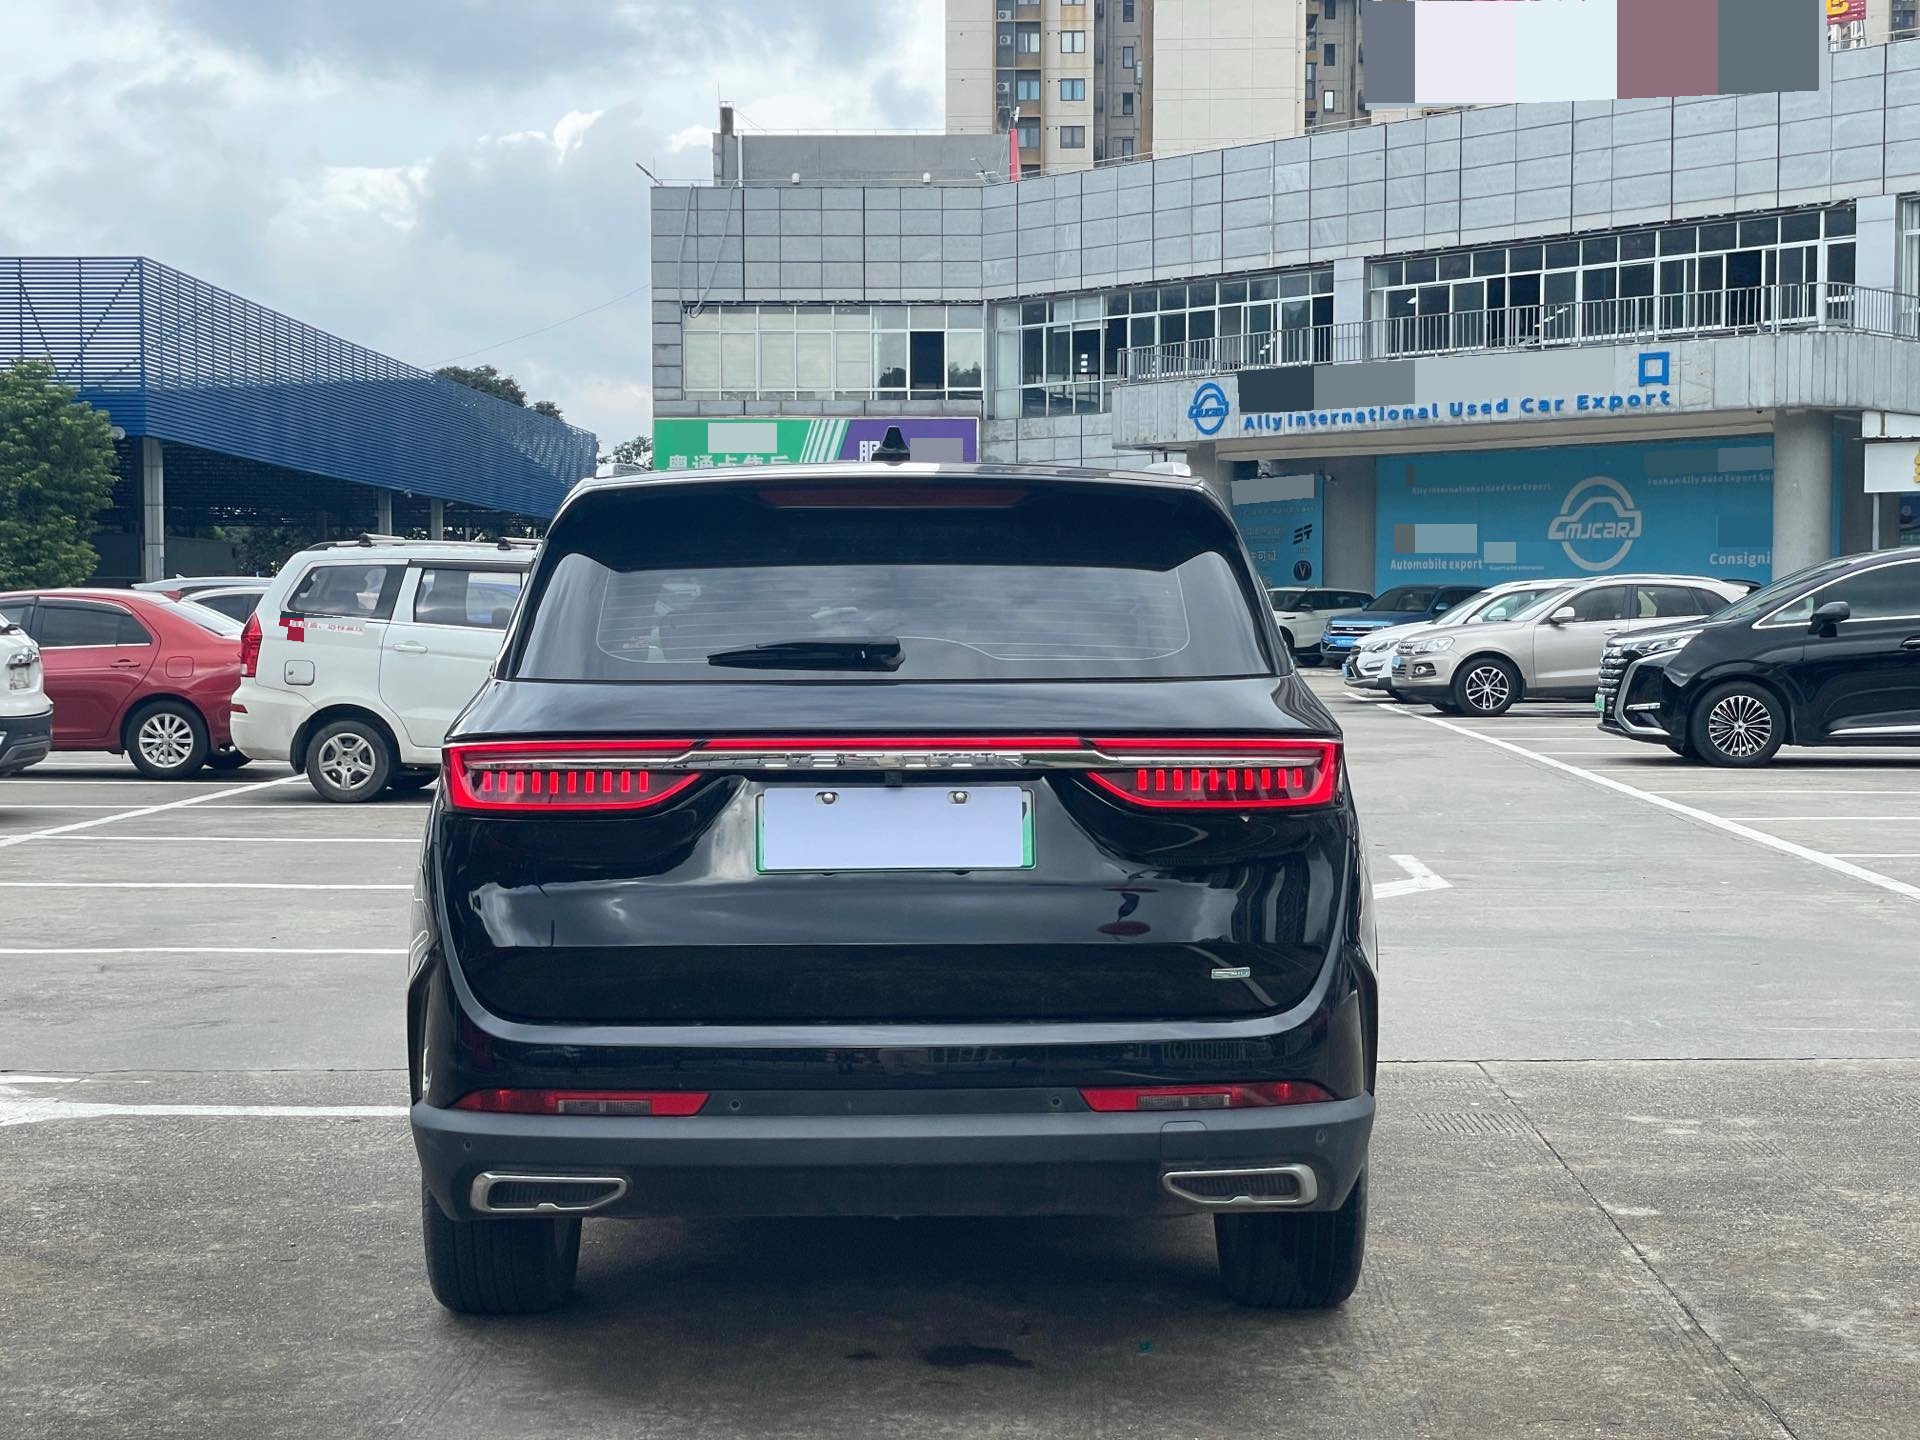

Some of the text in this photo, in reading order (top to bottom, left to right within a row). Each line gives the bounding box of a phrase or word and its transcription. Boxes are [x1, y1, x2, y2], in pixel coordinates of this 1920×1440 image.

[1243, 390, 1671, 431] Ally International Used Car Export
[1390, 557, 1447, 571] Automobile
[1449, 558, 1483, 573] export
